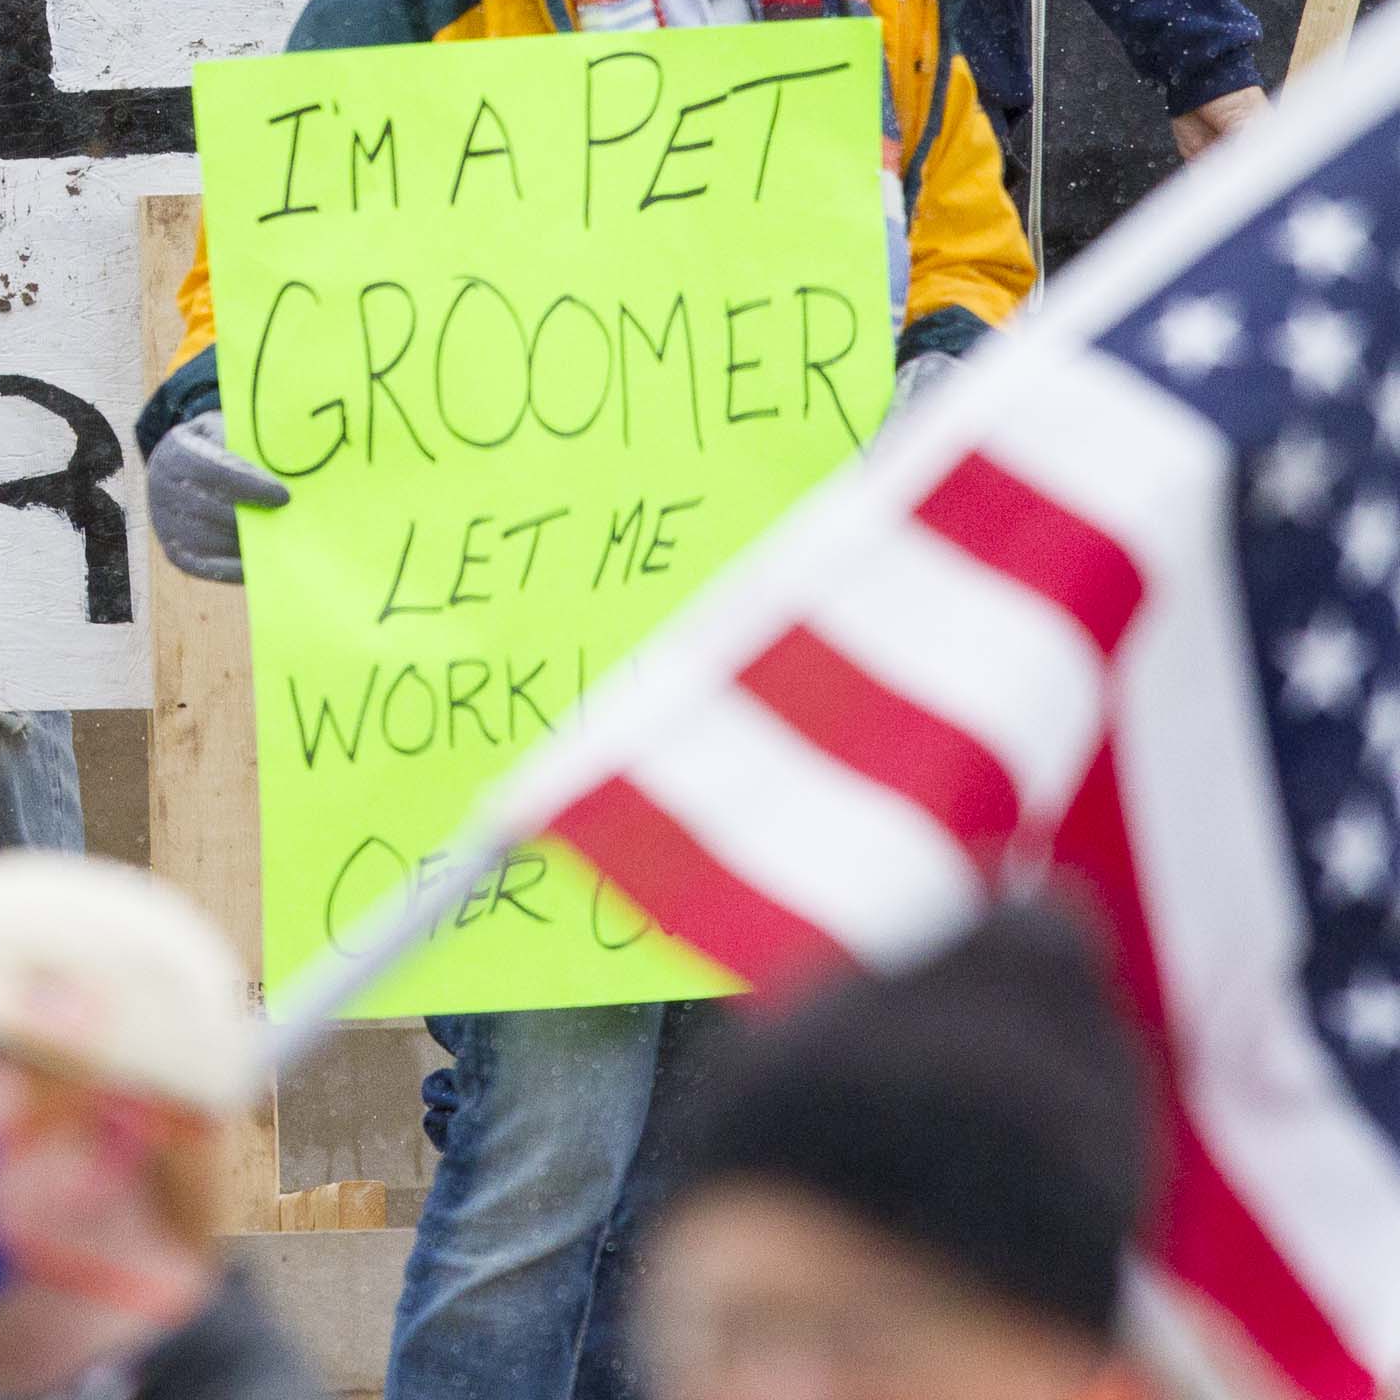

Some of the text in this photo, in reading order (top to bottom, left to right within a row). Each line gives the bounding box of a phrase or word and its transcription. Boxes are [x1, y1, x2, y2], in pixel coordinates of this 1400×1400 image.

[257, 51, 851, 230] I'M A PET
[251, 275, 868, 479] GROOMER
[378, 496, 706, 626] LET ME
